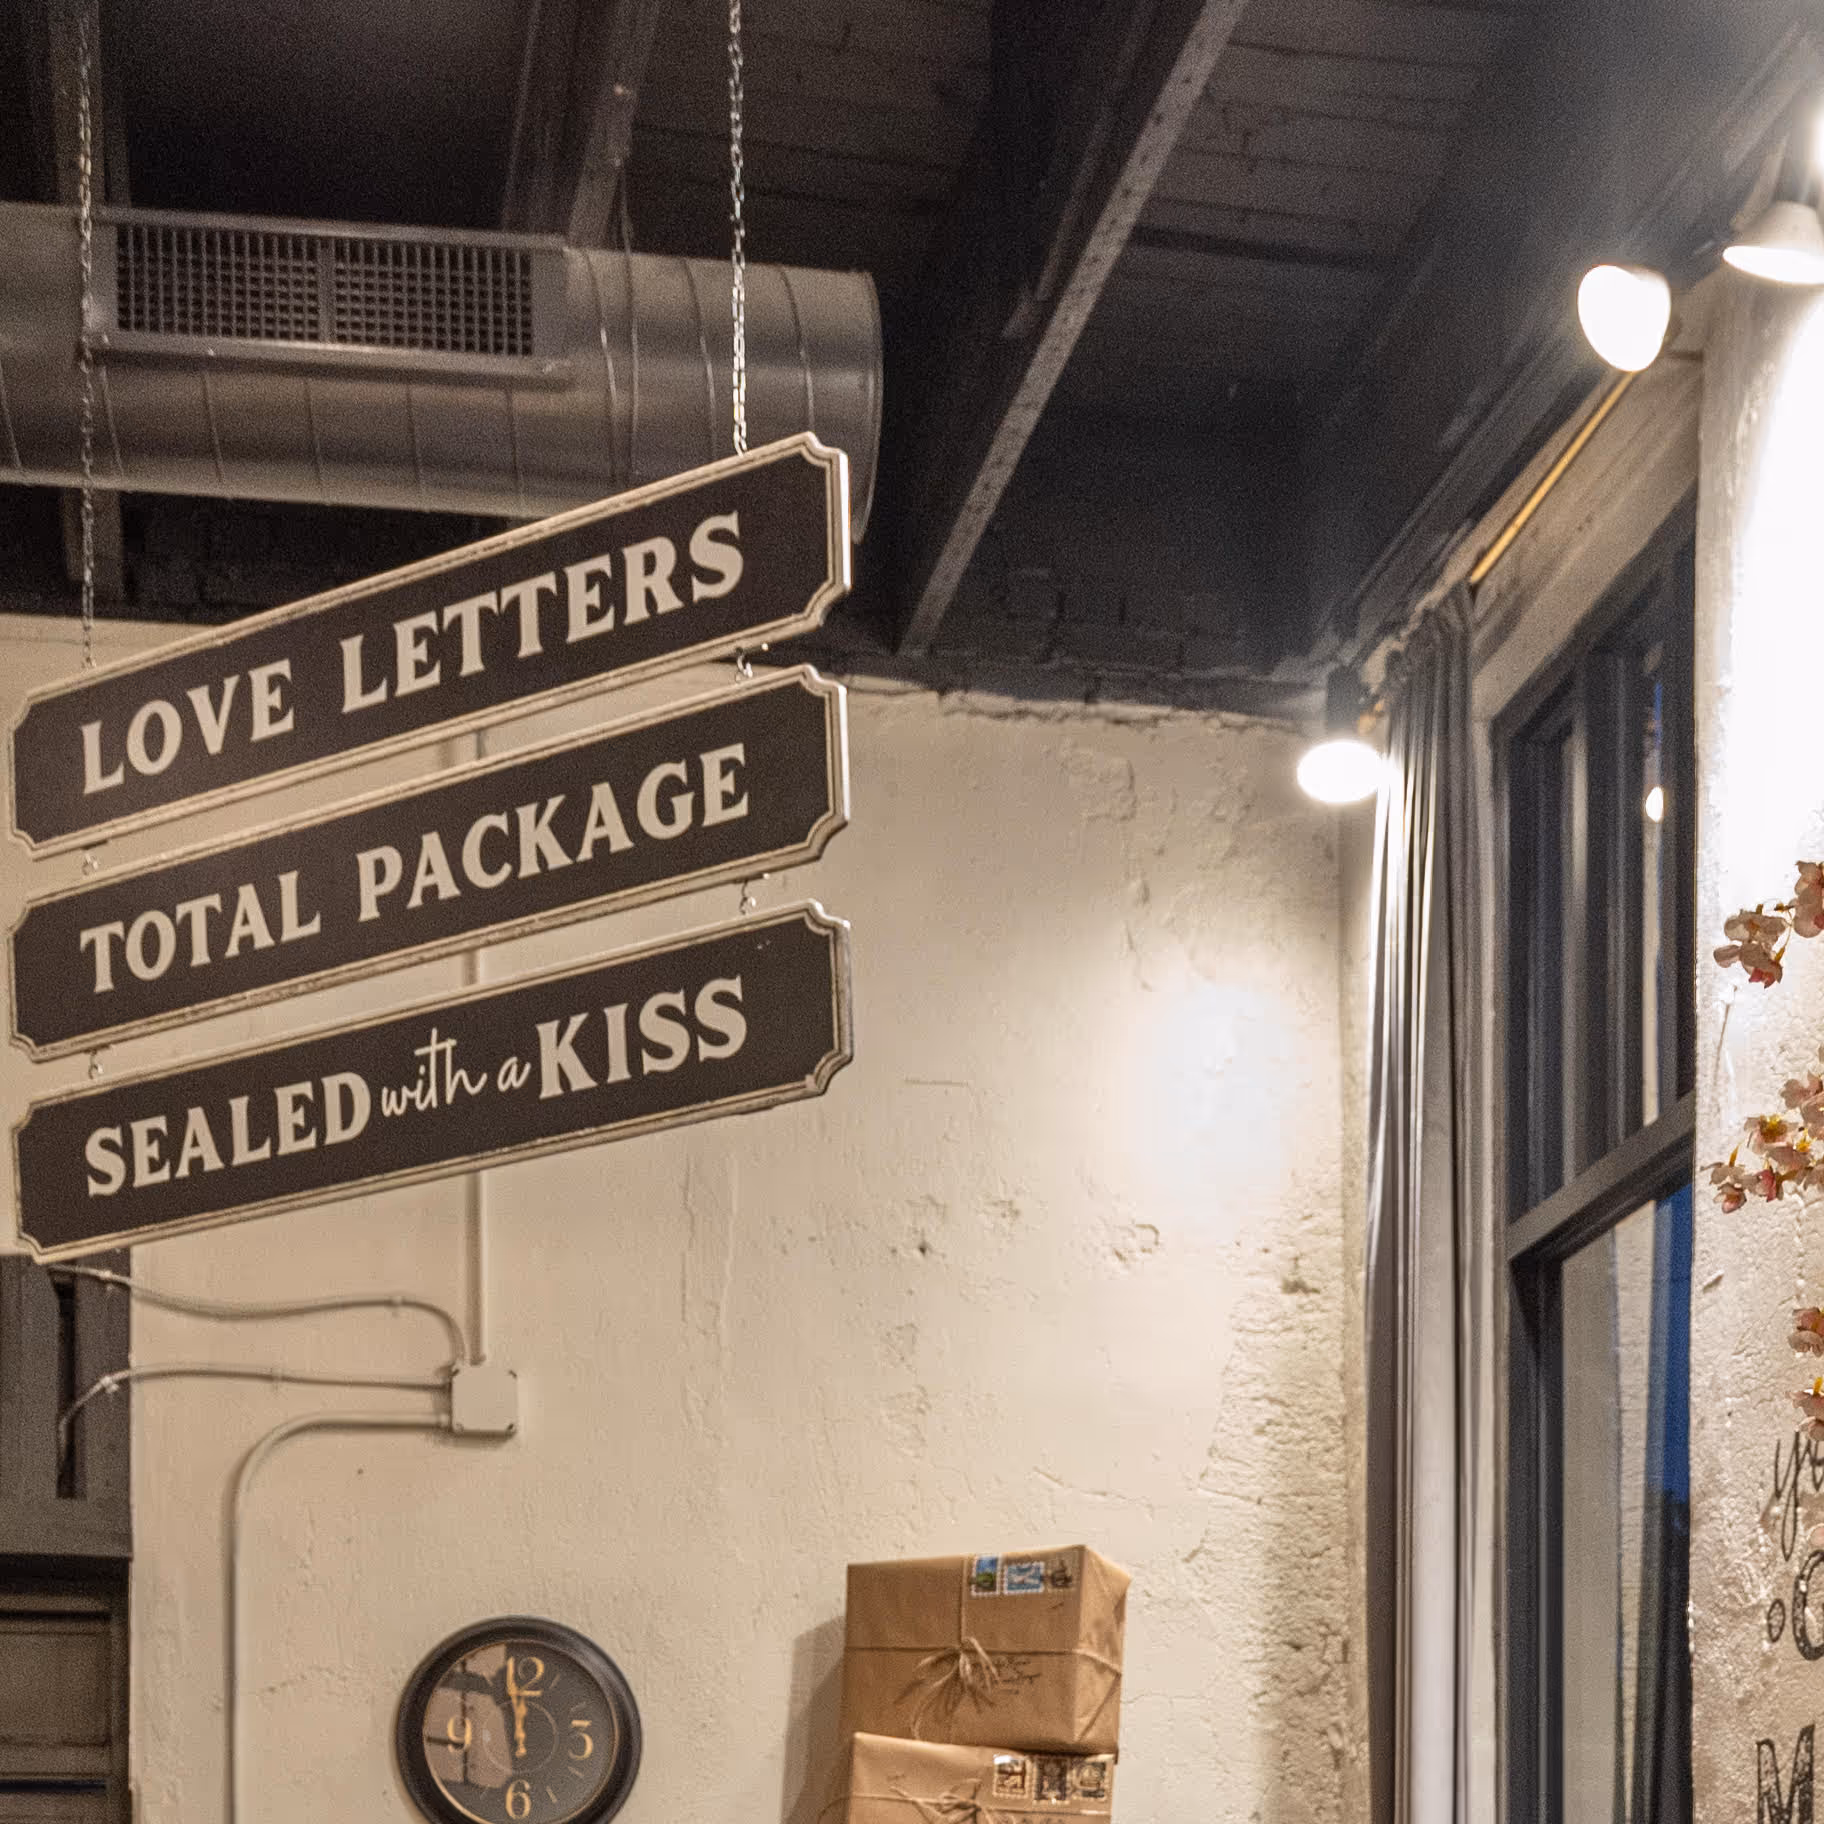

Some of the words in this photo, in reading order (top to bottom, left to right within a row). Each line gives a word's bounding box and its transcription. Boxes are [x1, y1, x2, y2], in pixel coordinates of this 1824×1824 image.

[80, 659, 295, 798] LOVE
[340, 511, 745, 714] LETTERS
[79, 872, 322, 994] TOTAL
[356, 743, 750, 923] PACKAGE
[84, 1069, 372, 1198] SEALED
[380, 1027, 488, 1120] with
[496, 1054, 531, 1089] a
[536, 975, 748, 1100] KISS
[506, 1655, 545, 1698] 12
[446, 1716, 472, 1754] 9
[567, 1719, 594, 1760] 3
[505, 1779, 531, 1820] 6
